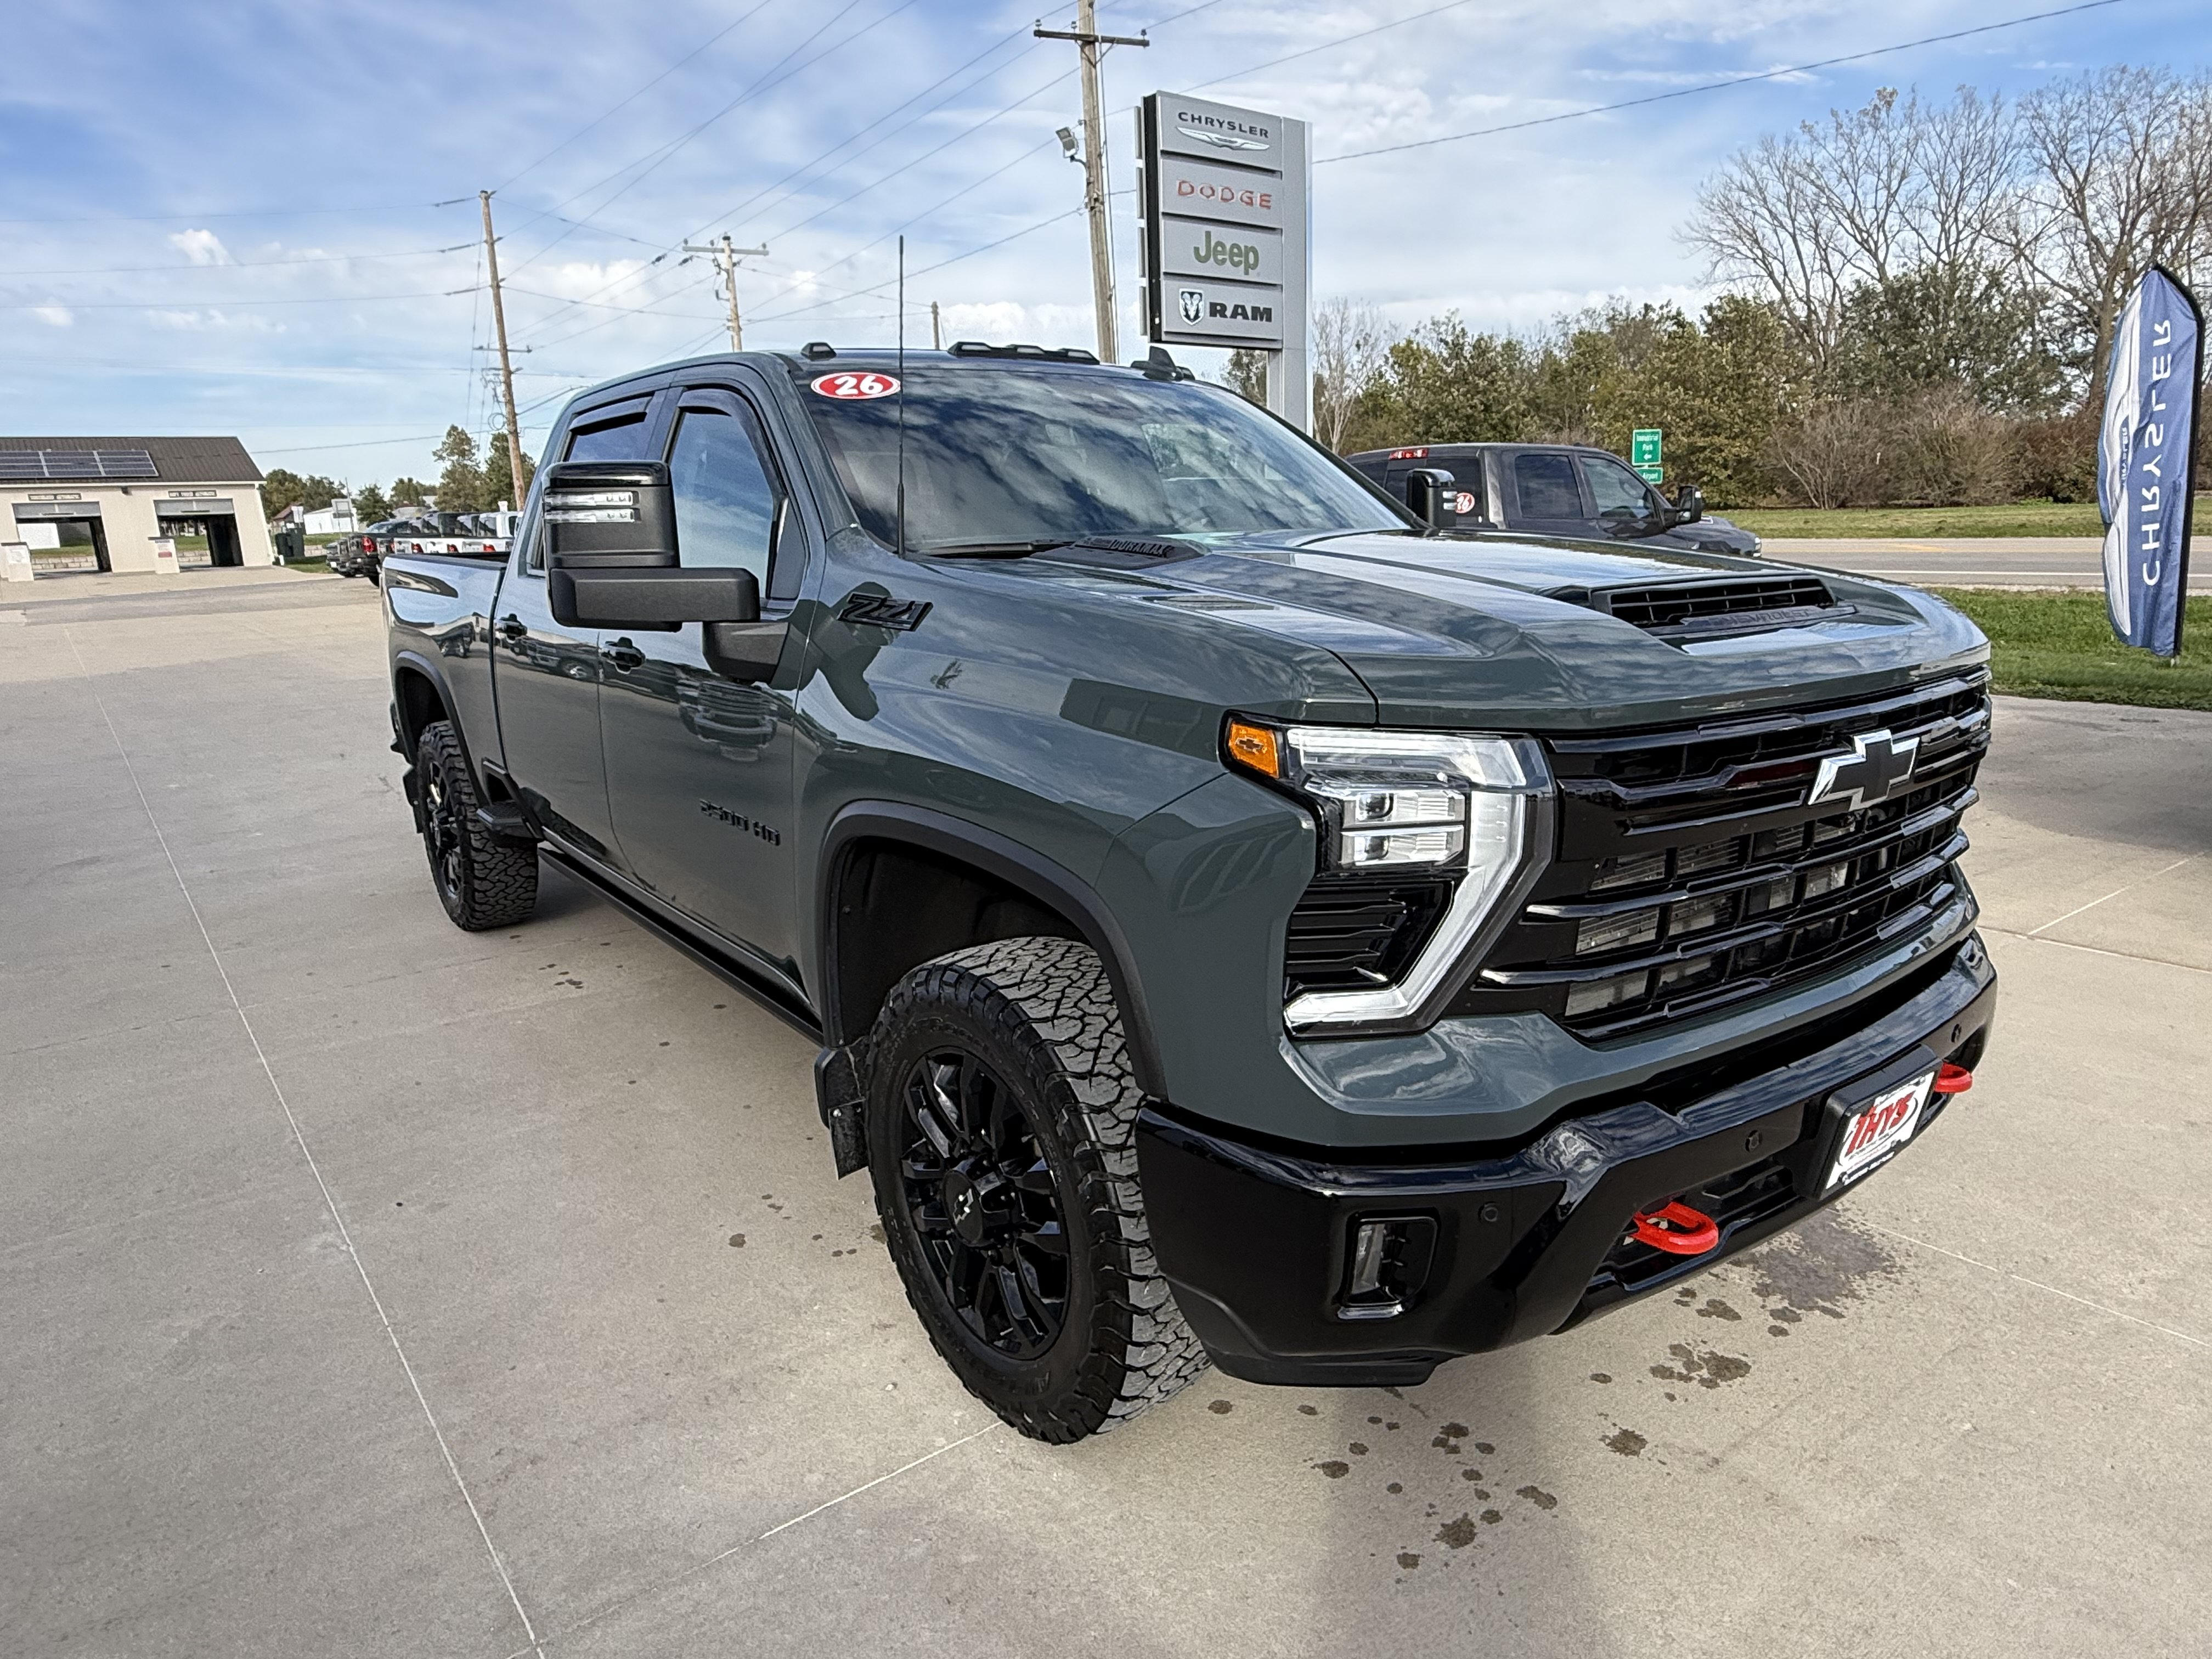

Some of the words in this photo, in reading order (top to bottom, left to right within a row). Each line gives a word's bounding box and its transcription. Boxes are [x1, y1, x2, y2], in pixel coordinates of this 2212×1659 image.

[1178, 111, 1269, 139] CHRYSLER
[1177, 179, 1273, 210] DODGE
[1193, 230, 1260, 275] Jeep
[1209, 302, 1273, 323] RAM
[833, 374, 884, 396] 26
[1110, 539, 1166, 556] DURAMAX
[1707, 608, 1810, 627] CHEVROLET
[752, 820, 781, 847] HD
